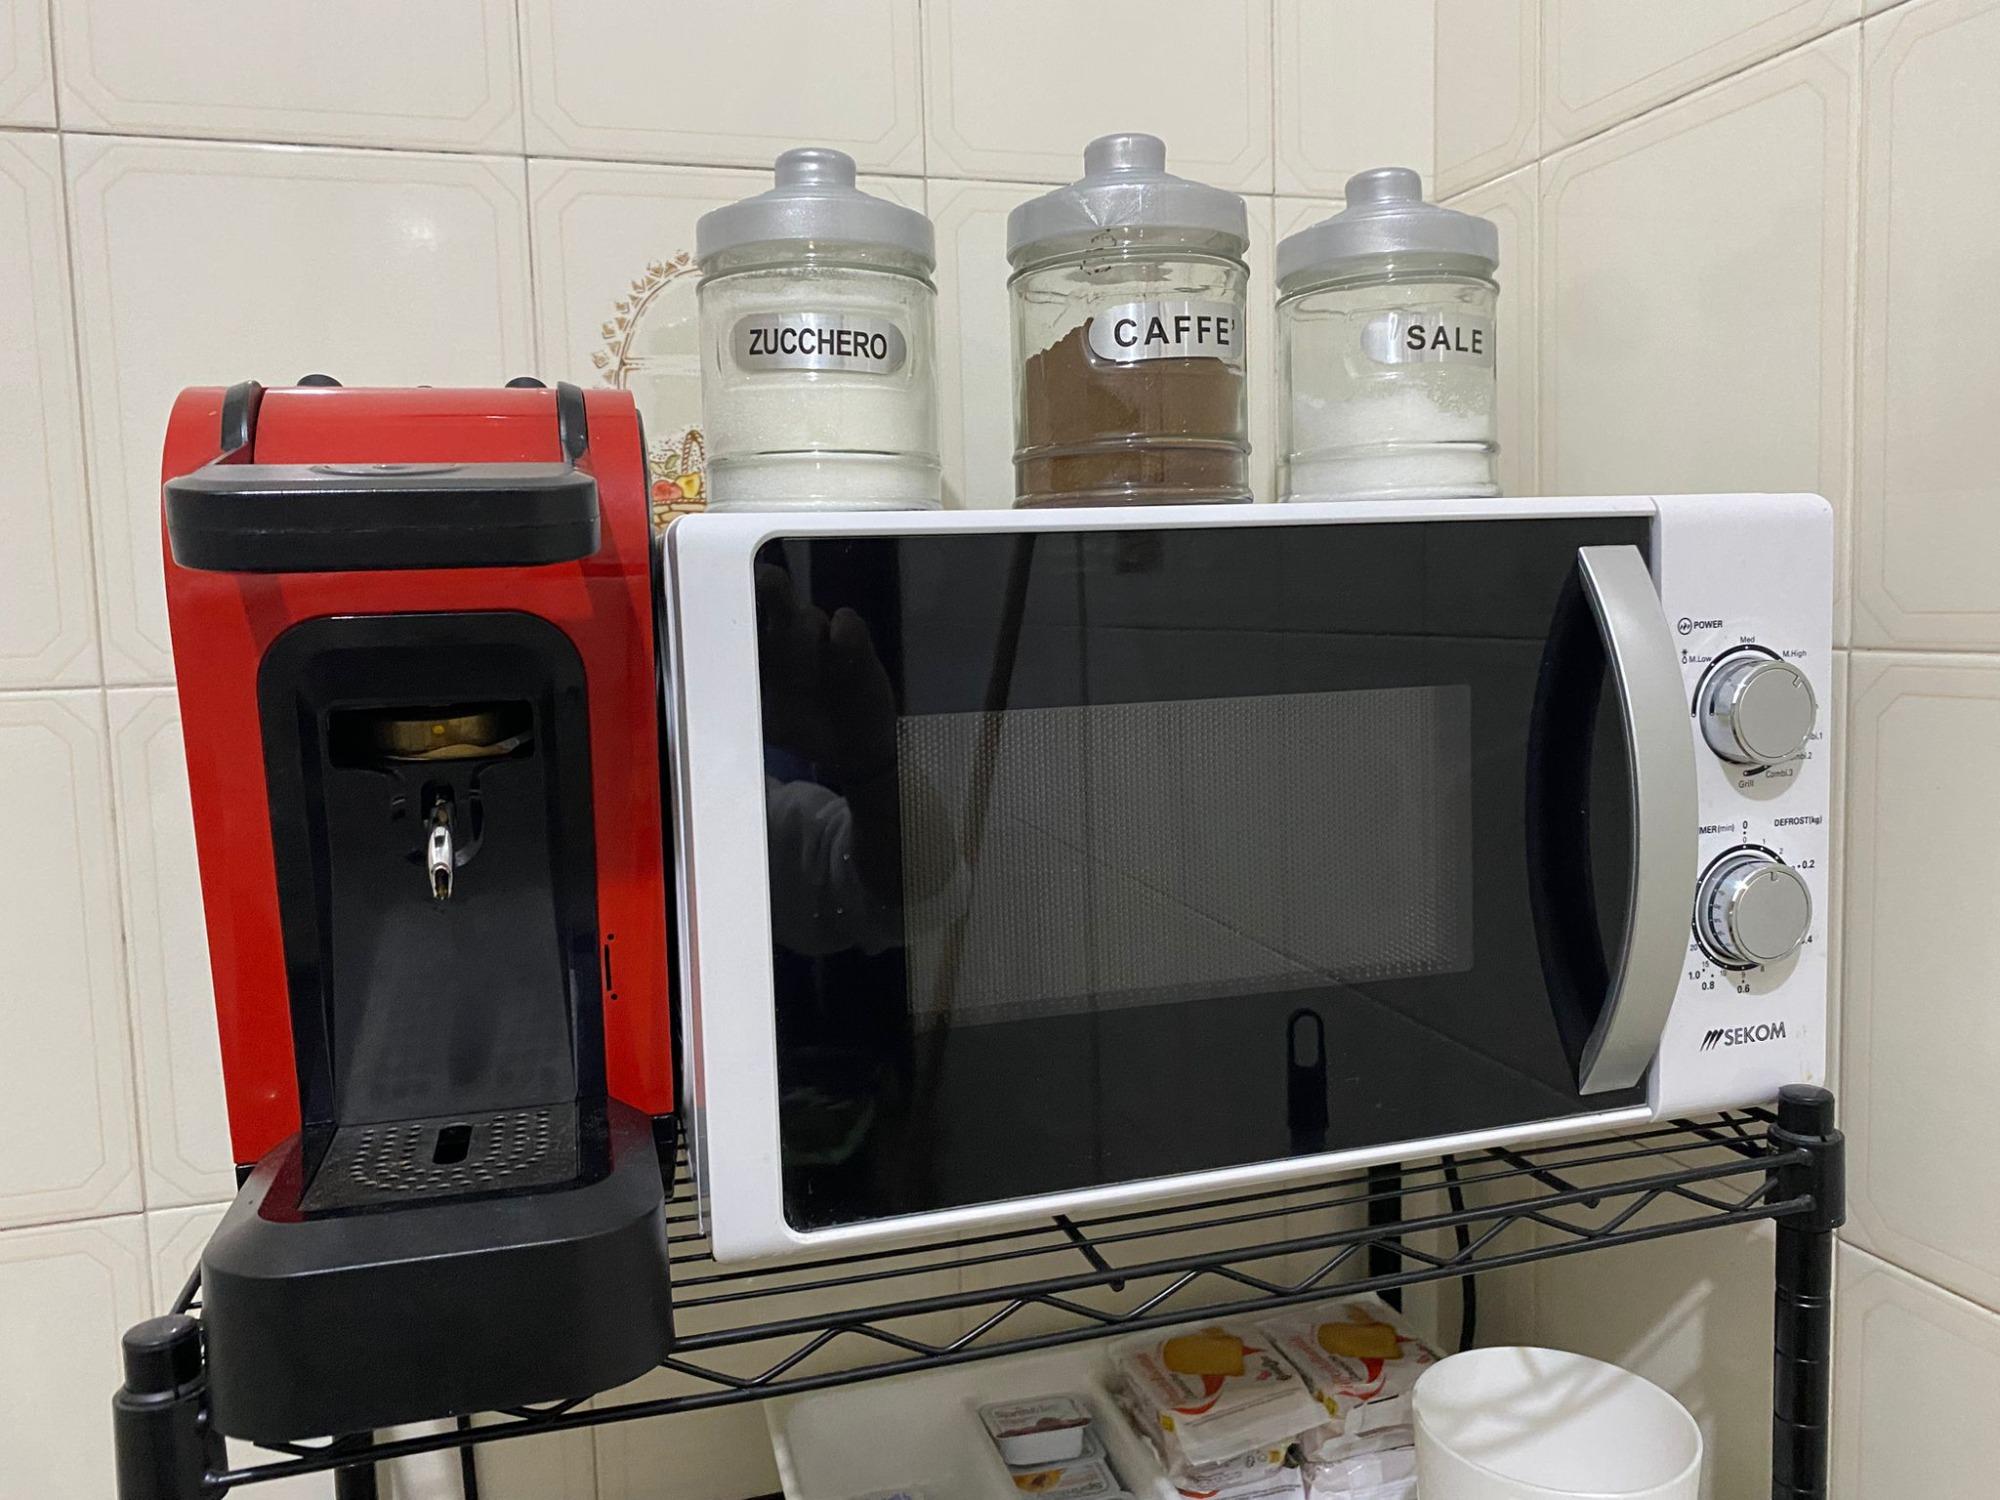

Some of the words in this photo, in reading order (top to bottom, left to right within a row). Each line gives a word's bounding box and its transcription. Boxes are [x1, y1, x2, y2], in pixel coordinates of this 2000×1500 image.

[1114, 316, 1235, 347] CAFFE'
[749, 328, 887, 359] ZUCCHERO
[1406, 325, 1483, 354] SALE
[1694, 620, 1723, 629] POWER
[1783, 650, 1807, 658] M.High
[1738, 780, 1754, 788] Grill
[1743, 820, 1748, 829] 0
[1743, 836, 1747, 844] 0
[1702, 960, 1710, 968] 15
[1688, 970, 1701, 980] 1.0
[1702, 981, 1715, 991] 0.8
[1737, 984, 1750, 994] 0.6
[1724, 1021, 1786, 1046] SEKOM
